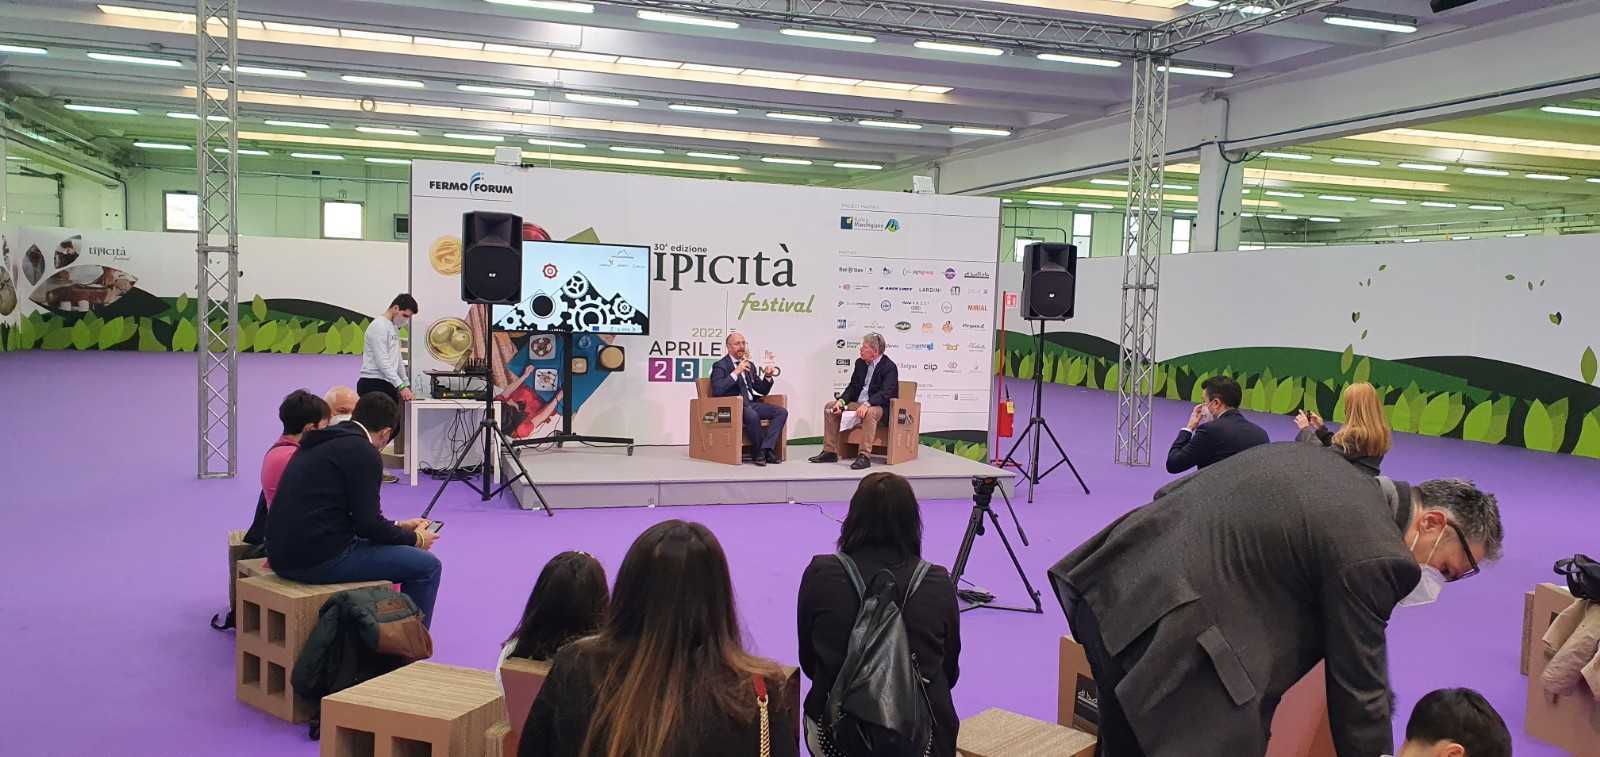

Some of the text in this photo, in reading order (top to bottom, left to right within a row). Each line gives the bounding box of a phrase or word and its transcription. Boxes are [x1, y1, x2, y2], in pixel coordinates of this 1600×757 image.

[429, 181, 513, 194] FERMO FORUM
[670, 244, 708, 254] edizione
[737, 292, 815, 320] festival
[691, 327, 723, 338] 2022
[648, 340, 722, 356] APRILE
[654, 360, 668, 379] 2
[680, 361, 694, 379] 3
